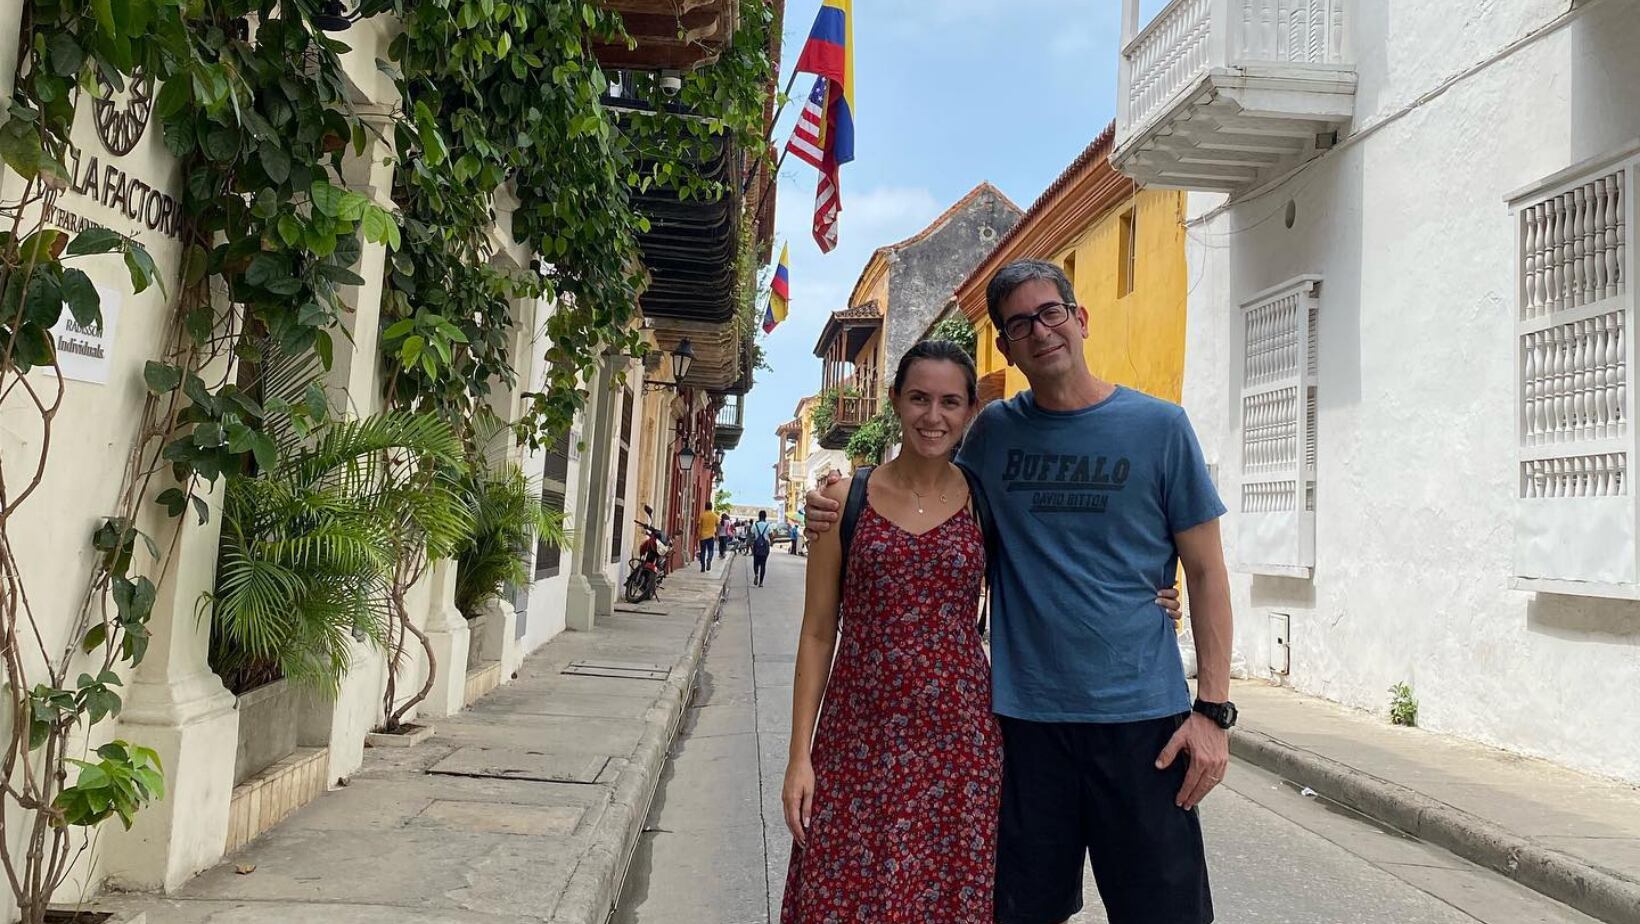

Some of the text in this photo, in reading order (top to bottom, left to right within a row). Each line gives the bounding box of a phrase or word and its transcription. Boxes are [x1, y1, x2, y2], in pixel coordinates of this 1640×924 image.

[70, 149, 99, 201] LA
[100, 165, 184, 242] FACTORIA
[57, 335, 105, 359] Individuals
[1002, 448, 1131, 485] BUFFALO
[1031, 491, 1109, 508] DAVID BITTON
